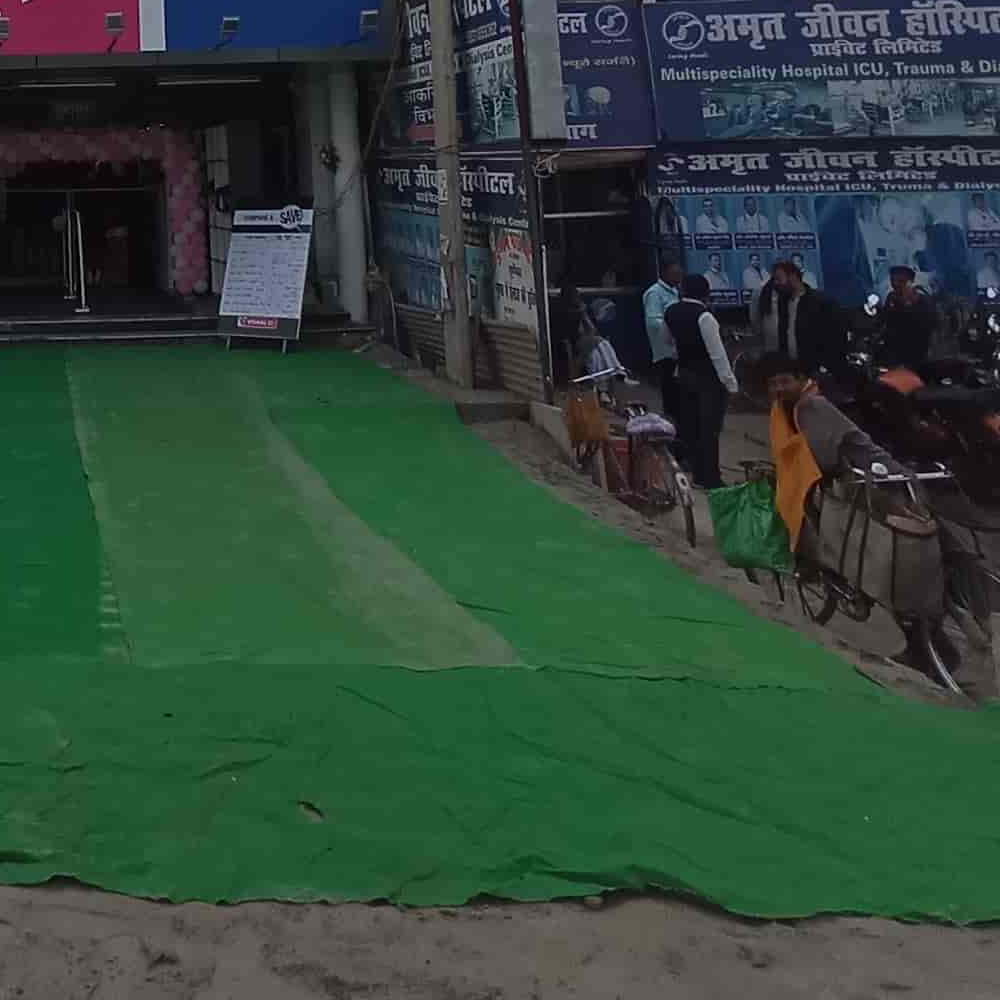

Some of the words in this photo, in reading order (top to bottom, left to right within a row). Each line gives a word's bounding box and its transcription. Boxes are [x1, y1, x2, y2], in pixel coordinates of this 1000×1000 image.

[705, 11, 786, 50] अमृत
[796, 3, 891, 38] जीवन
[660, 66, 777, 82] Multispeciality
[782, 64, 849, 80] Hospital
[854, 62, 889, 77] ICU,
[893, 61, 955, 76] Trauma
[960, 60, 974, 74] &
[979, 59, 1000, 74] Di
[687, 153, 770, 175] अमृत
[780, 148, 878, 169] जीवन
[890, 144, 1000, 167] हॉस्पीट
[776, 184, 840, 192] Hospital
